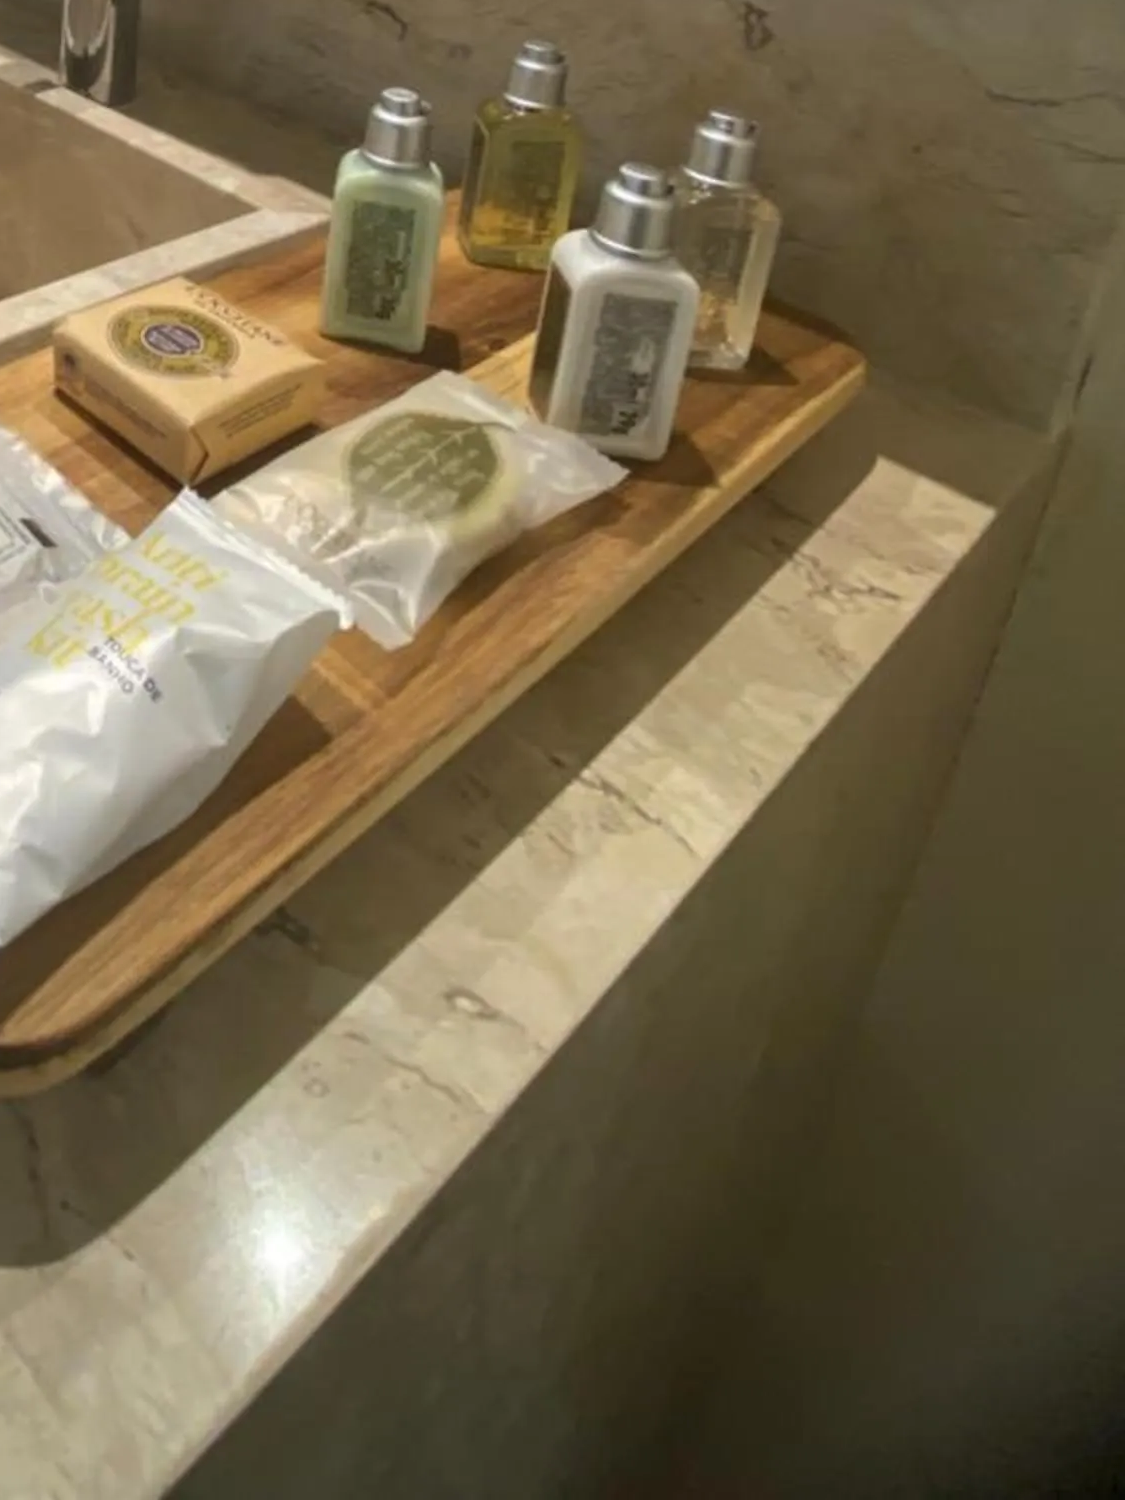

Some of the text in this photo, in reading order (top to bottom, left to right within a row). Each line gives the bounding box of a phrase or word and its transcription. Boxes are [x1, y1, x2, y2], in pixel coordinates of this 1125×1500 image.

[87, 647, 135, 694] BANHO
[103, 636, 164, 703] TOUCA DE
